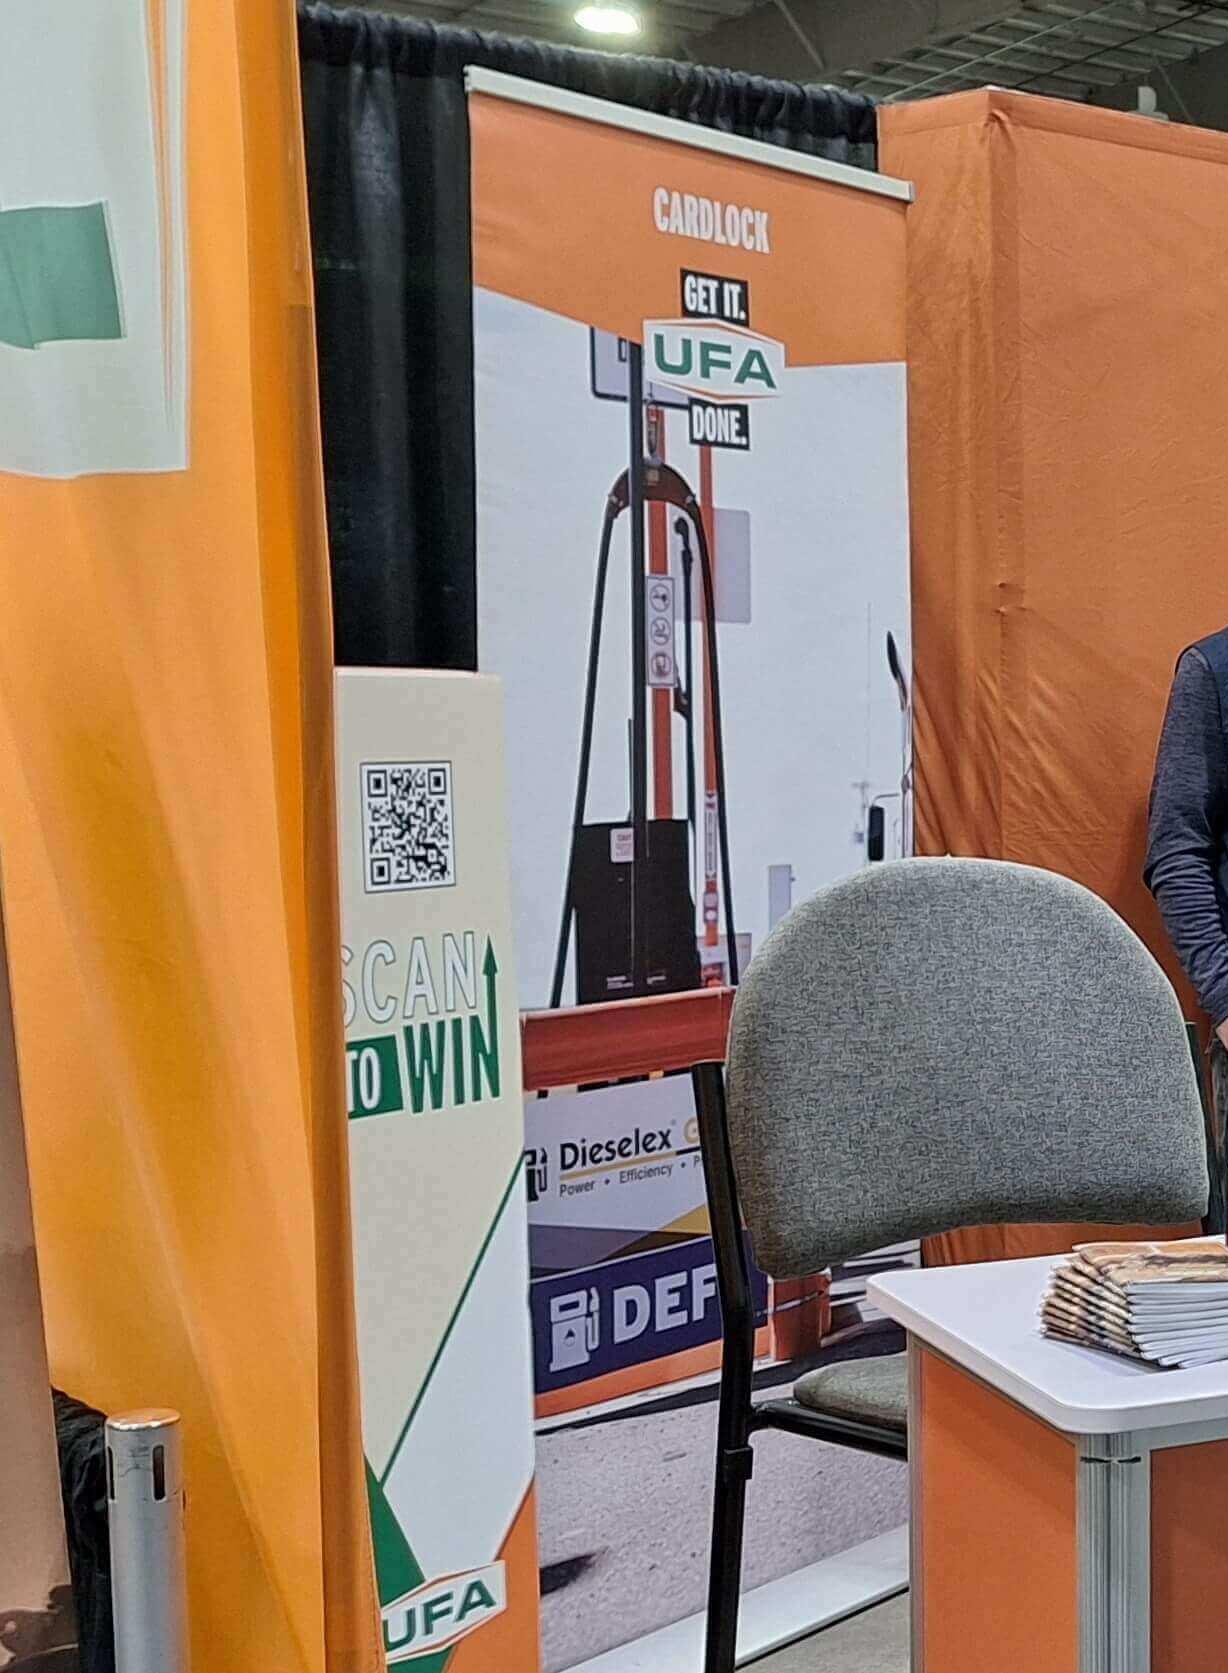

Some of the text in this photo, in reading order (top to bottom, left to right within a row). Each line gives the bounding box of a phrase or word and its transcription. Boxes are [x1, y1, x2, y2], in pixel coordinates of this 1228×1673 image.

[654, 187, 769, 254] CARDLOCK
[684, 275, 746, 320] GET IT.
[654, 333, 776, 389] UFA
[691, 405, 747, 445] DONE.
[402, 1013, 500, 1113] WIN
[559, 1179, 595, 1198] Power
[619, 1161, 673, 1184] Efficiency
[613, 1264, 717, 1344] DEF
[383, 1579, 497, 1651] UFA
